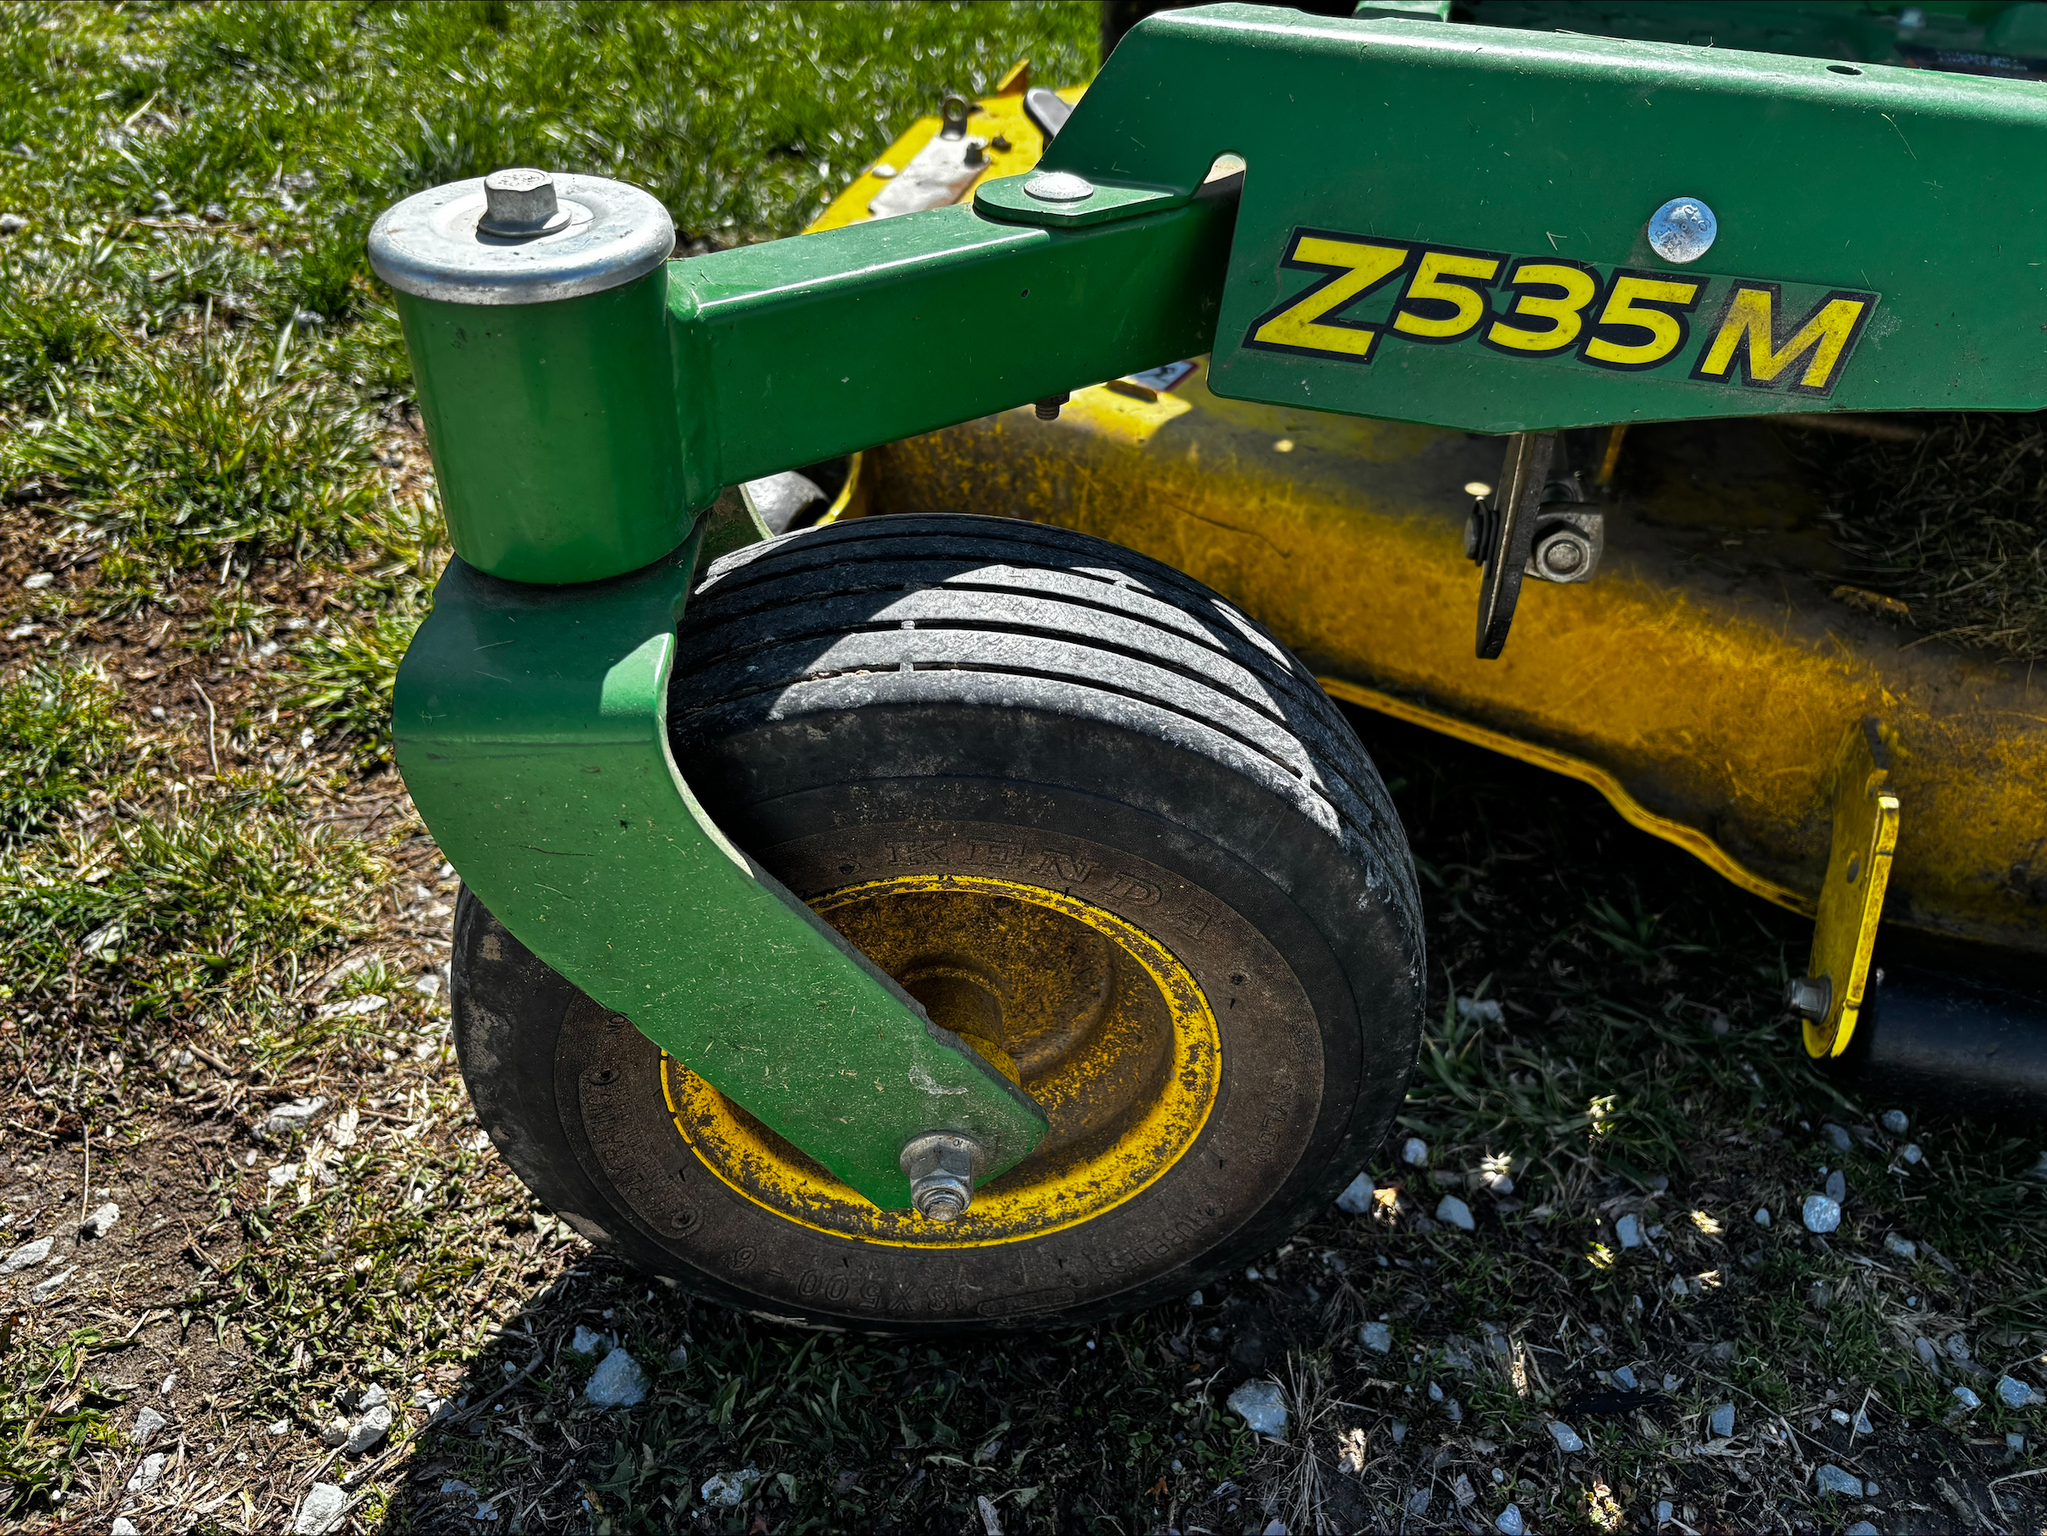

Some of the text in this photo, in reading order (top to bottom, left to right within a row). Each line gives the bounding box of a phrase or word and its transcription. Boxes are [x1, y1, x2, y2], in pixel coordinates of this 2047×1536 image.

[1248, 231, 1870, 392] Z535M
[883, 837, 1214, 938] KENDA
[1248, 1083, 1293, 1163] NYLON
[1095, 1213, 1209, 1280] TUBELESS
